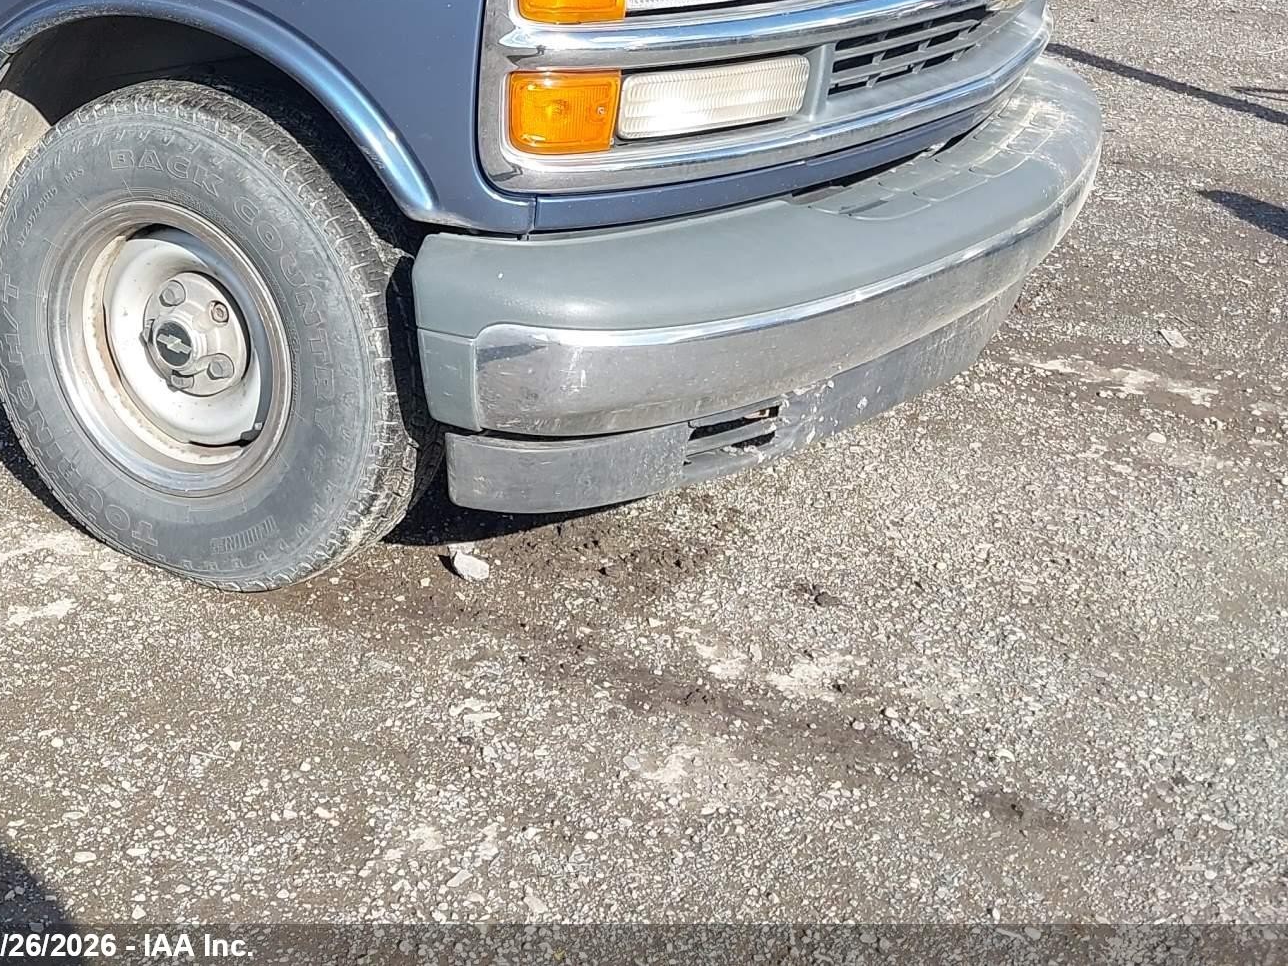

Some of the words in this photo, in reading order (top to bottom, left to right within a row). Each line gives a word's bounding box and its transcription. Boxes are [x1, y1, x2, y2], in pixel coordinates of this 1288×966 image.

[1, 274, 24, 366] H/T
[109, 148, 224, 198] BACK
[233, 196, 336, 440] COUNTRY
[17, 379, 159, 547] TOURING
